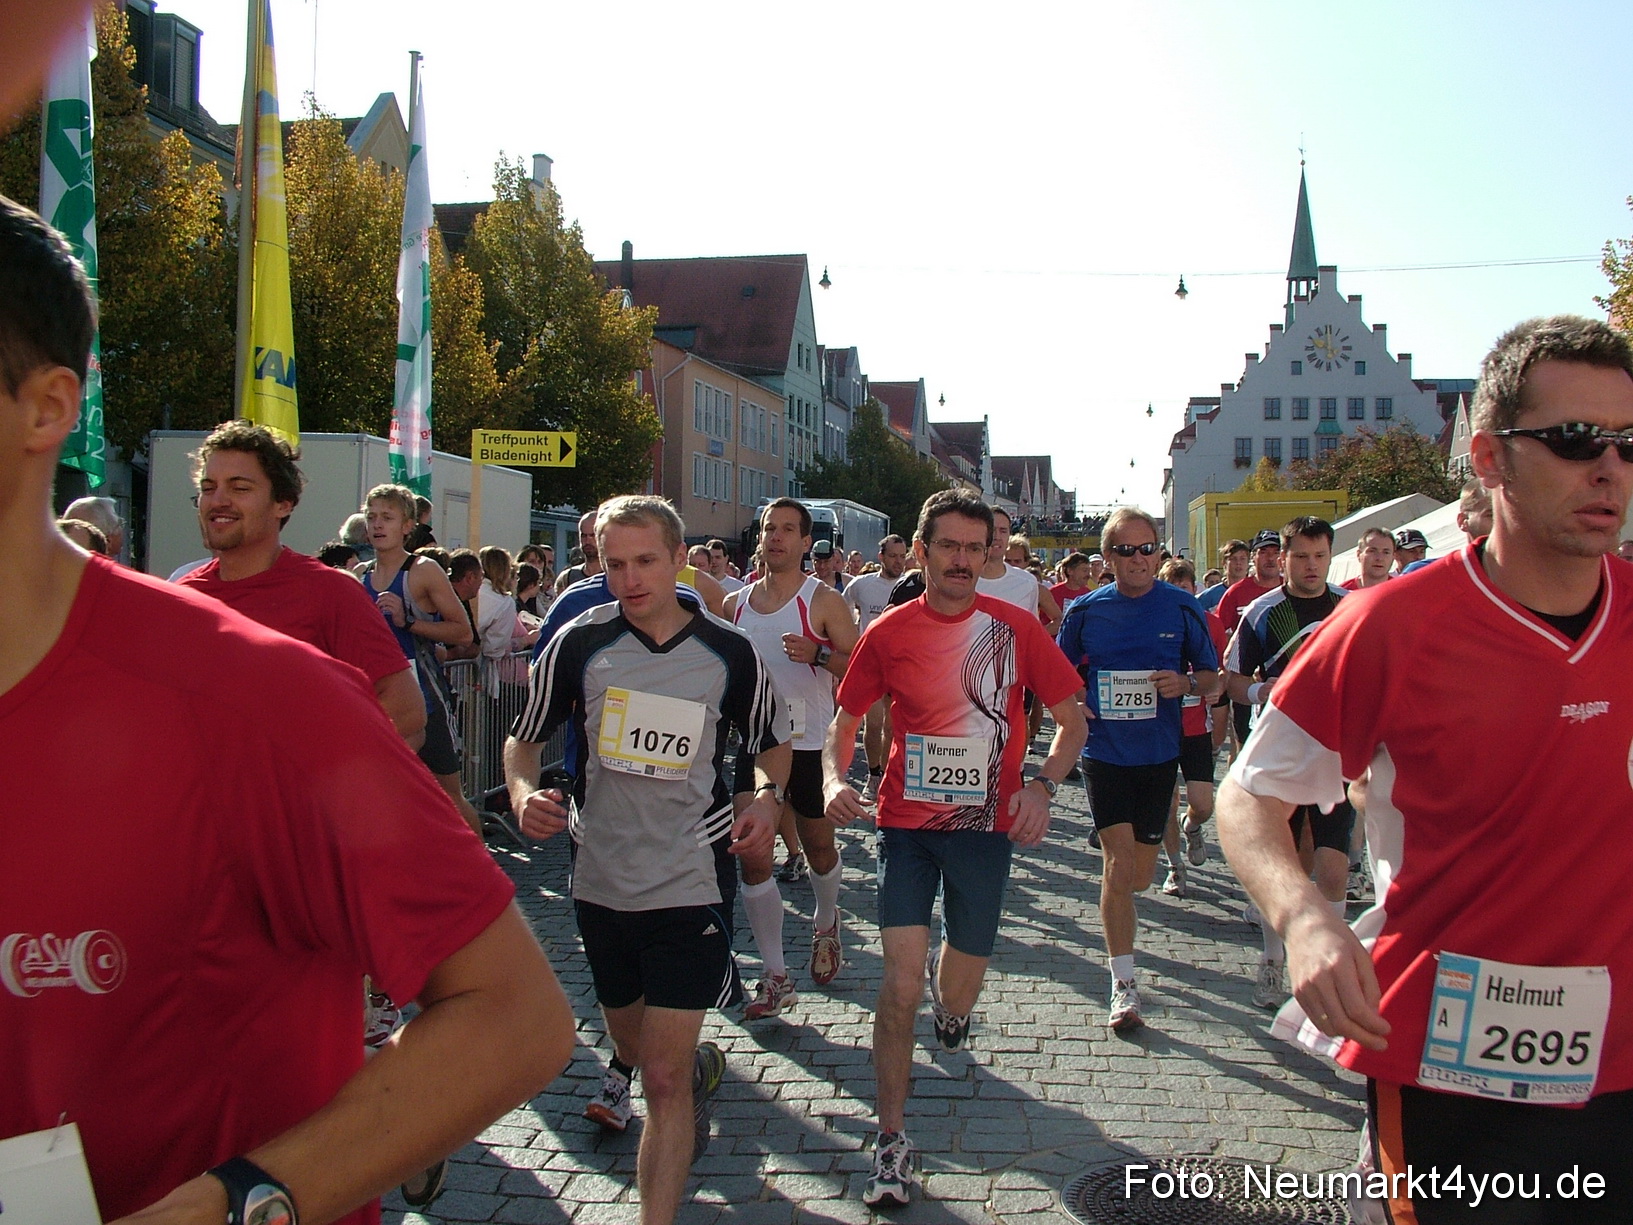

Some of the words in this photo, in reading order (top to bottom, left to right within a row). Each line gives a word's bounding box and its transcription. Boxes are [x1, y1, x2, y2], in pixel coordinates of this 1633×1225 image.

[480, 433, 549, 448] Treffpunkt
[480, 449, 553, 464] Bladenight
[1113, 676, 1147, 685] Hermann
[1115, 692, 1152, 706] 2785
[630, 727, 691, 757] 1076
[927, 742, 967, 757] Werner
[909, 760, 914, 769] B
[928, 766, 980, 787] 2293
[1486, 975, 1565, 1006] Helmut
[1437, 1008, 1448, 1027] A
[1480, 1025, 1591, 1066] 2695
